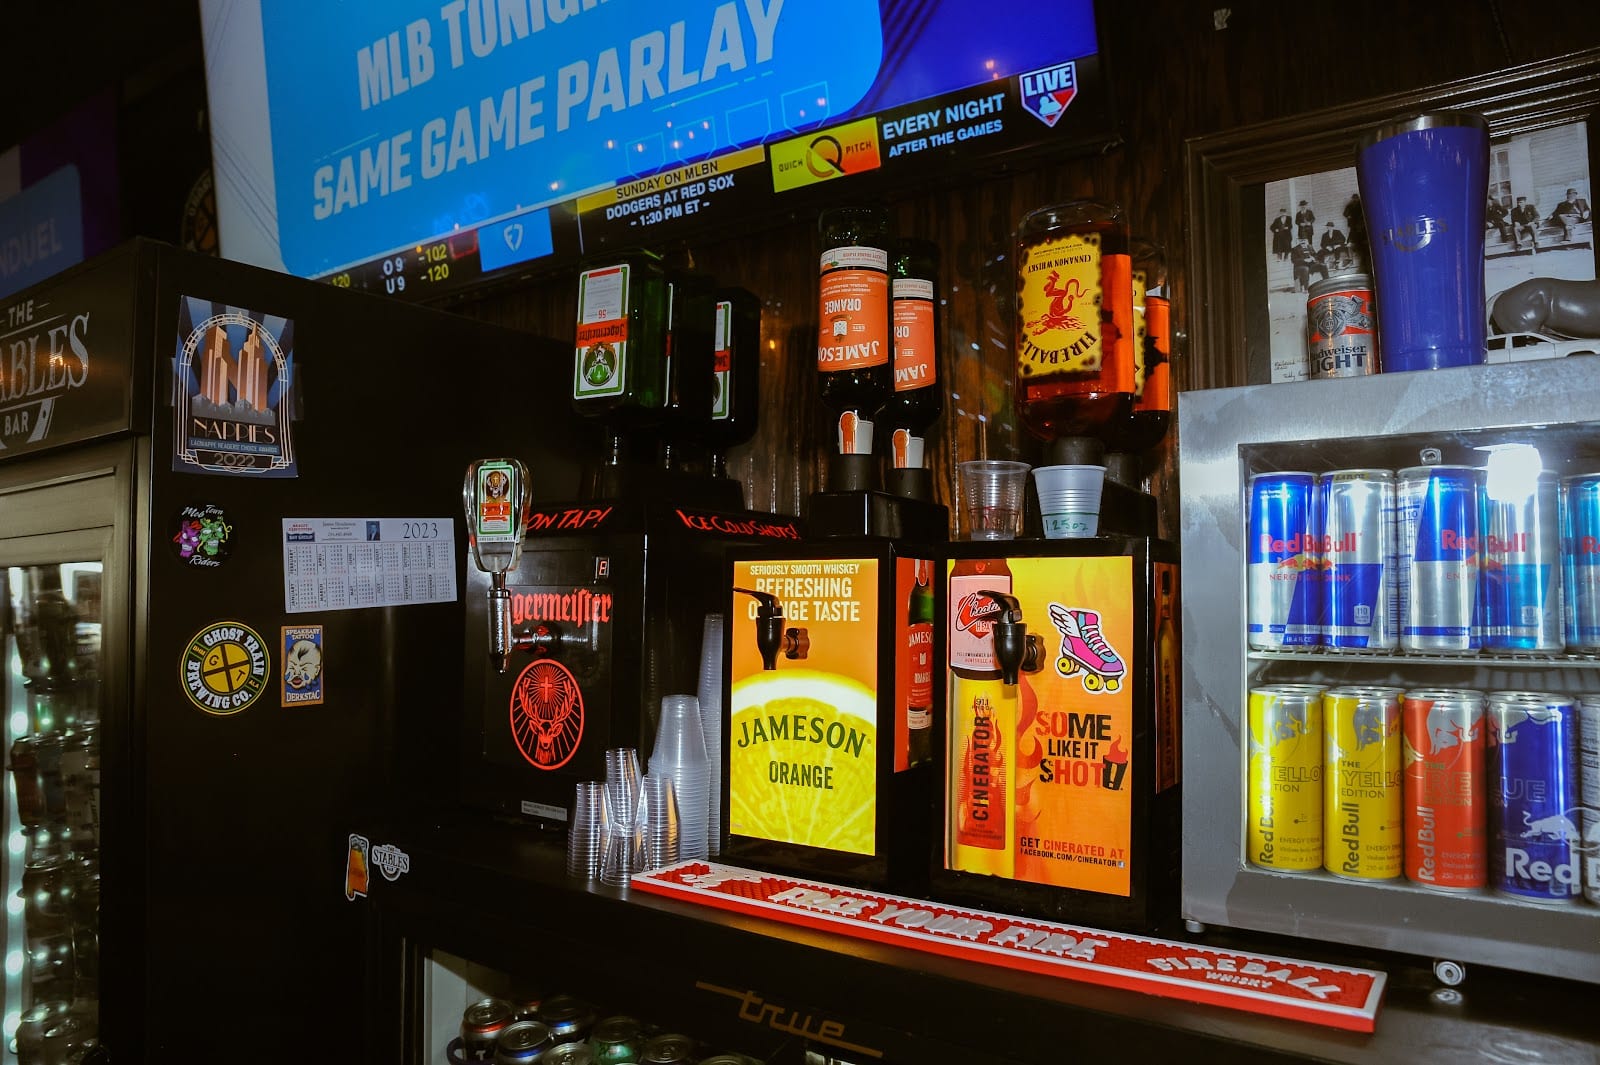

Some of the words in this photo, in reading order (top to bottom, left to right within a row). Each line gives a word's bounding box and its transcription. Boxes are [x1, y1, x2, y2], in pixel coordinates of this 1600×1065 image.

[357, 18, 435, 111] MLB
[1024, 67, 1072, 97] LIVE
[313, 130, 413, 221] SAME
[421, 75, 547, 180] GAME
[556, 0, 786, 133] PARLAY
[883, 110, 942, 141] EVERY
[946, 93, 1006, 127] NIGHT
[846, 141, 872, 154] PITCH
[888, 138, 928, 158] AFTER
[930, 133, 955, 151] THE
[957, 119, 1003, 146] GAMES
[616, 176, 661, 200] SUNDAY
[664, 171, 682, 187] ON
[685, 160, 718, 182] MLBN
[606, 196, 661, 222] DODGERS
[662, 192, 678, 208] AT
[681, 182, 706, 203] RED
[709, 173, 735, 194] SOX
[640, 207, 663, 228] 1:30
[665, 203, 682, 219] PM
[685, 200, 700, 214] ET
[418, 243, 448, 265] -102
[1027, 260, 1053, 274] WHISKY
[1054, 255, 1091, 268] CINNAMON
[386, 278, 395, 294] U
[420, 263, 450, 283] -120
[8, 299, 34, 327] THE
[824, 298, 862, 315] ORANGE
[1024, 331, 1098, 364] FIREBALL
[5, 411, 29, 436] BAR
[193, 418, 276, 444] NAPPIES
[214, 452, 256, 468] 2022
[402, 522, 439, 540] 2023
[526, 513, 559, 532] ON
[562, 506, 613, 529] TAP!
[188, 554, 221, 567] Riders
[750, 563, 789, 575] SERIOUSLY
[790, 563, 822, 575] SMOOTH
[823, 563, 860, 575] WHISKEY
[756, 577, 853, 599] REFRESHING
[1269, 573, 1302, 582] NERGY
[511, 586, 613, 628] germeister
[748, 600, 809, 622] ONGE
[813, 600, 861, 622] TASTE
[285, 628, 320, 636] SPEAKEASY
[975, 620, 995, 633] HEA
[203, 628, 244, 647] GHOST
[243, 635, 265, 676] TRAIN
[209, 655, 219, 666] G
[186, 661, 231, 709] BREWING
[232, 690, 252, 707] CO.
[236, 670, 245, 682] T
[737, 714, 867, 758] JAMESON
[1036, 711, 1111, 741] SOME
[1048, 738, 1082, 759] LIKE
[1083, 741, 1099, 760] IT
[768, 759, 834, 790] ORANGE
[972, 716, 991, 821] CINERATOR
[1342, 760, 1360, 769] THE
[1342, 769, 1400, 788] YELLO
[1423, 770, 1472, 797] RE
[1342, 787, 1385, 799] EDITION
[1341, 803, 1360, 836] Bull
[1416, 805, 1436, 842] Bull
[373, 849, 408, 870] STABLES
[1020, 836, 1041, 848] GET
[1043, 839, 1105, 858] CINERATED
[1110, 848, 1124, 859] AT
[1020, 848, 1118, 867] FACEBOOK.COM/CINERATOR
[1259, 830, 1273, 865] Red
[1341, 838, 1360, 874] Red
[1417, 843, 1436, 881] Red
[1505, 838, 1582, 895] Red
[988, 926, 1110, 962] FIRE
[1146, 955, 1342, 1000] FIREBALL
[1206, 971, 1274, 989] WHISKY
[738, 990, 845, 1041] true
